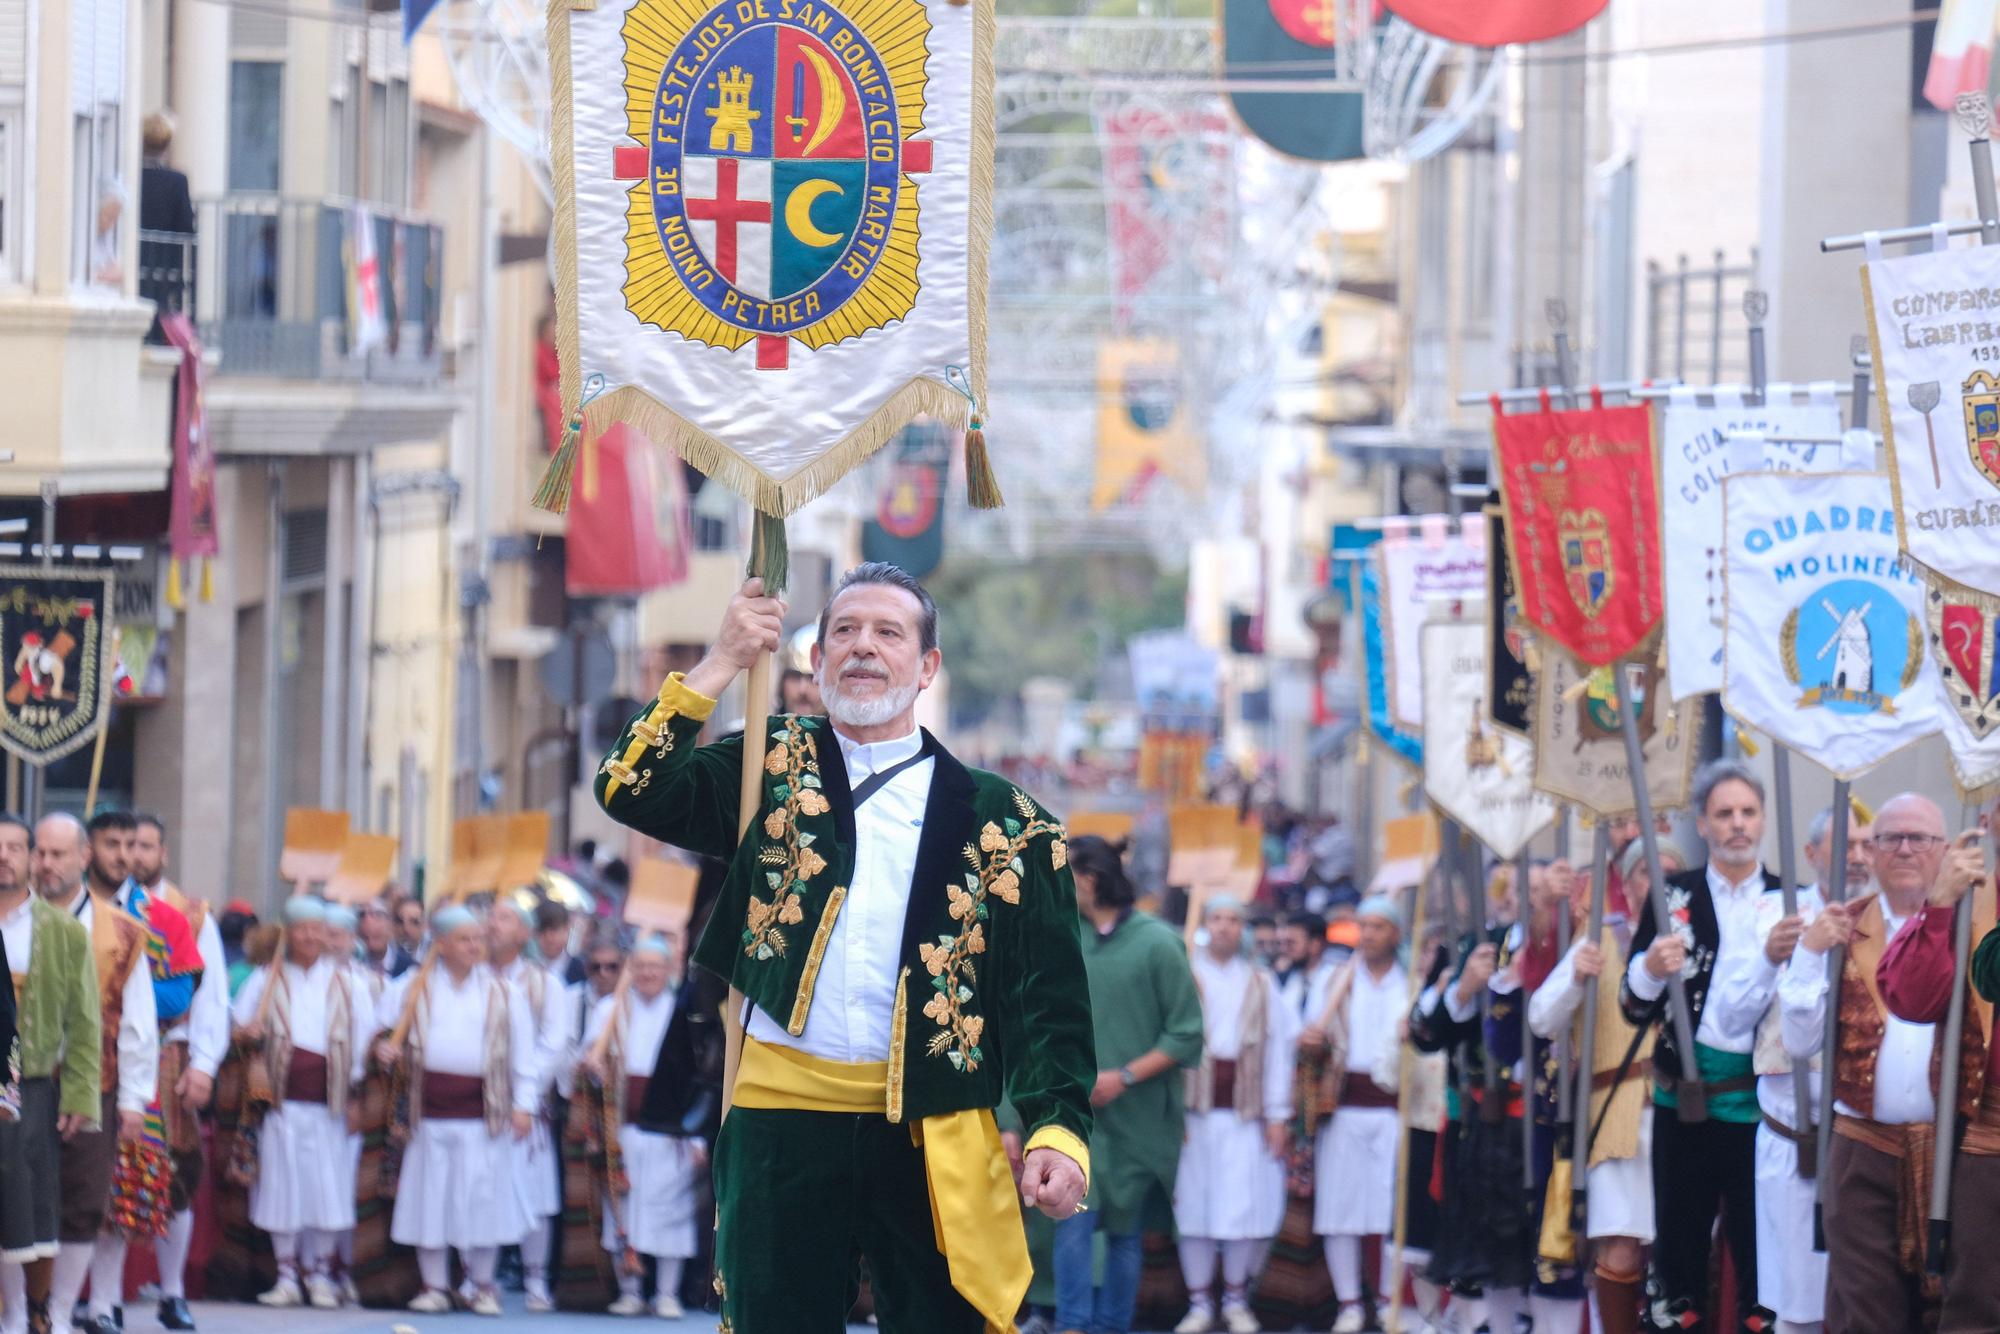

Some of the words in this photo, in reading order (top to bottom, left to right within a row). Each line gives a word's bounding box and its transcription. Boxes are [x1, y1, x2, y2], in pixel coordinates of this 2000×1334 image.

[736, 0, 771, 23] DE
[778, 0, 833, 34] SAN
[657, 21, 735, 145] FESTEJOS
[830, 27, 895, 163] BONIFACIO
[655, 166, 679, 195] DE
[662, 215, 714, 290] UNION
[840, 185, 891, 280] MARTIR
[720, 289, 821, 326] PETRER
